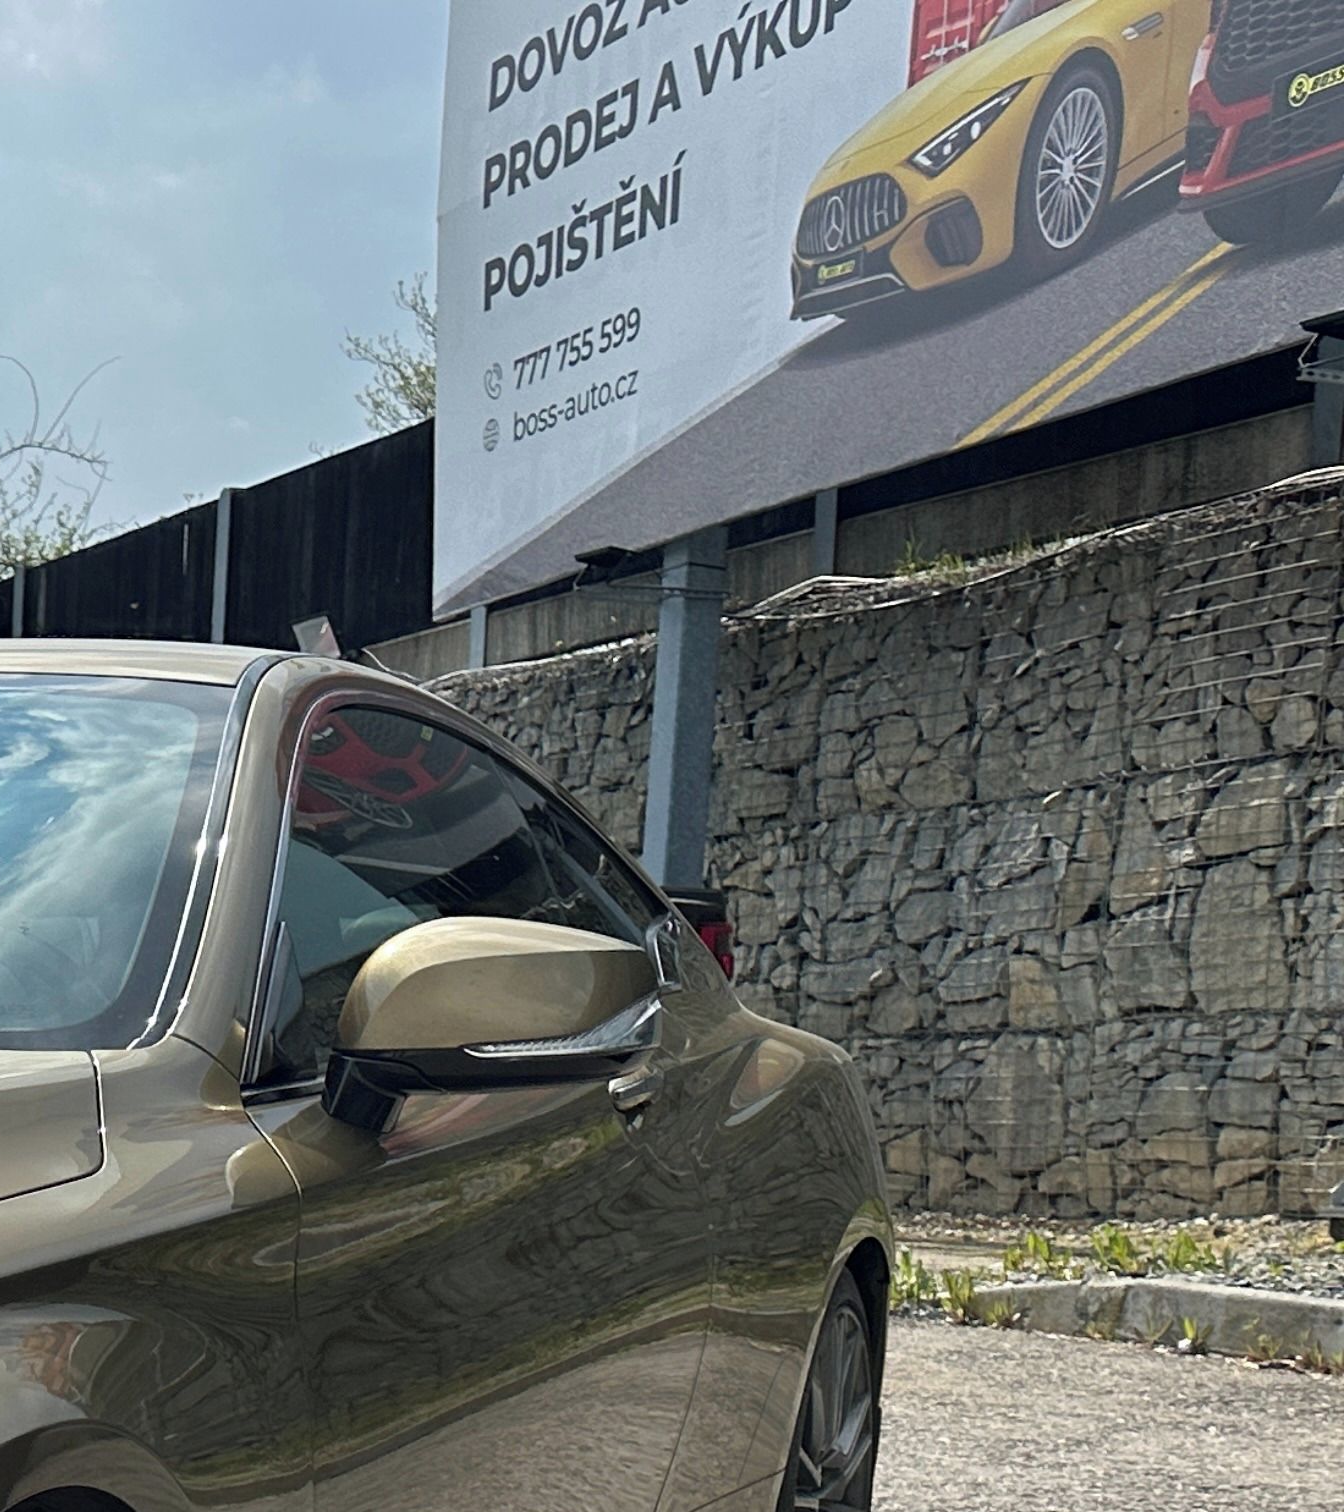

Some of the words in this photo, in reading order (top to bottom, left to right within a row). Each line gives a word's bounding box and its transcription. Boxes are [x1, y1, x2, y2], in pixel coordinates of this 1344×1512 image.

[488, 0, 628, 113] DOVOZ
[483, 78, 640, 210] PRODEJ
[648, 60, 681, 125] A
[483, 148, 688, 312] POJIŠTĚNÍ
[513, 345, 552, 390] 777
[556, 326, 594, 372] 755
[599, 307, 642, 353] 599
[513, 370, 640, 442] boss-auto.cz
